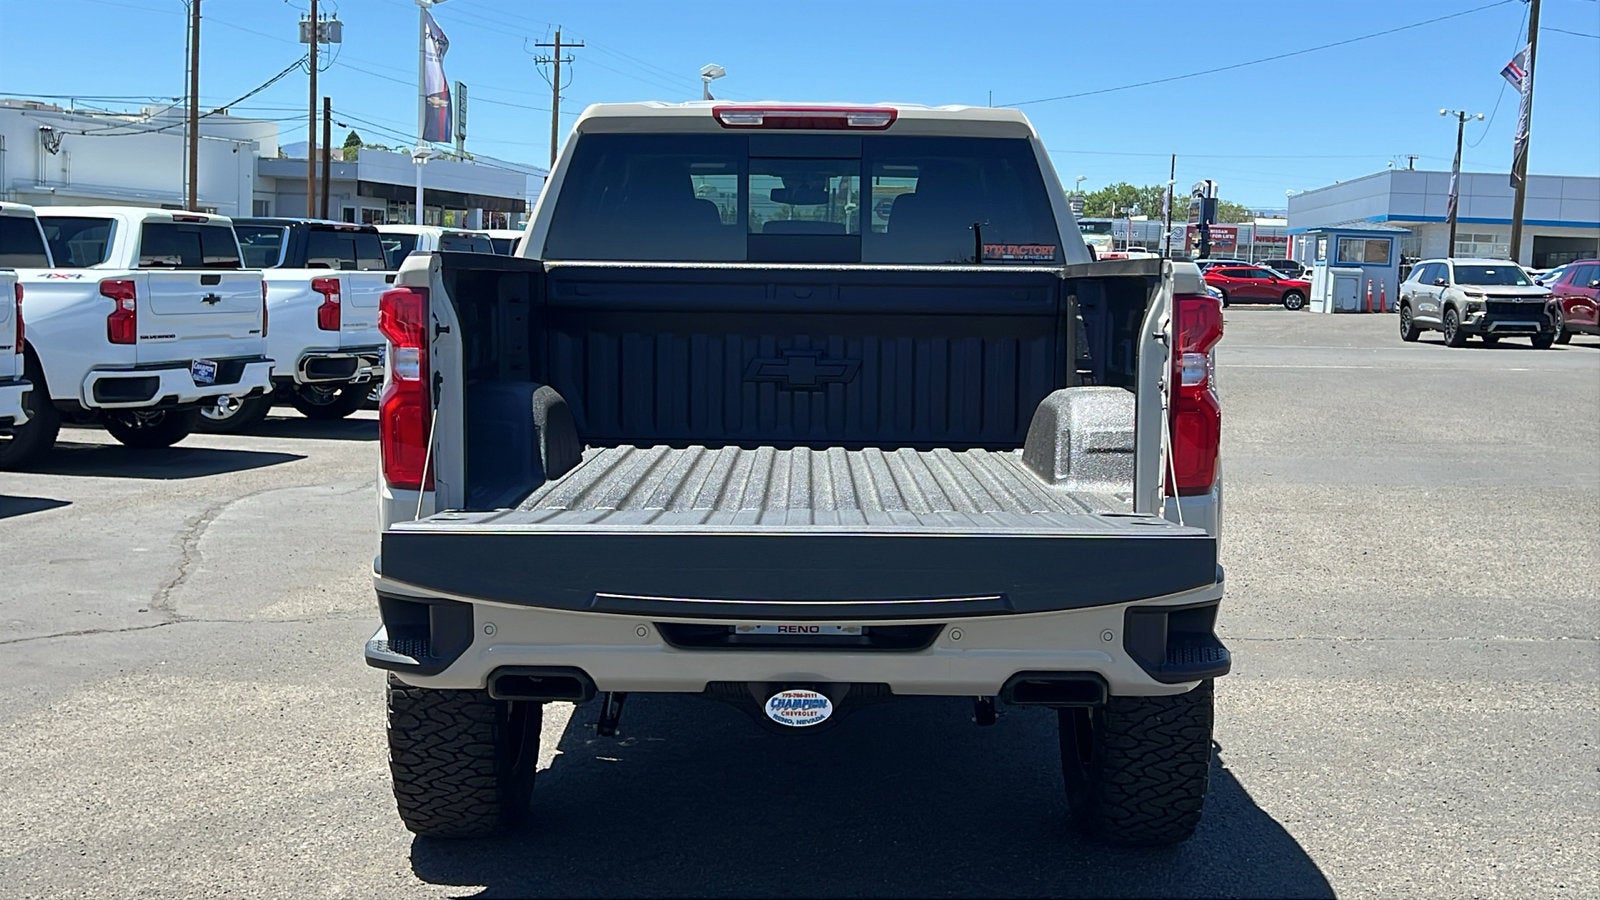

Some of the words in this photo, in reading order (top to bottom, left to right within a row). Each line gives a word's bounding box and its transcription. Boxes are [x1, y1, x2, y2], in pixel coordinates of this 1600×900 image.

[1007, 245, 1056, 255] FACTORY
[777, 625, 820, 633] RENO
[770, 697, 828, 709] CHAMPION
[796, 714, 826, 725] NEVADA
